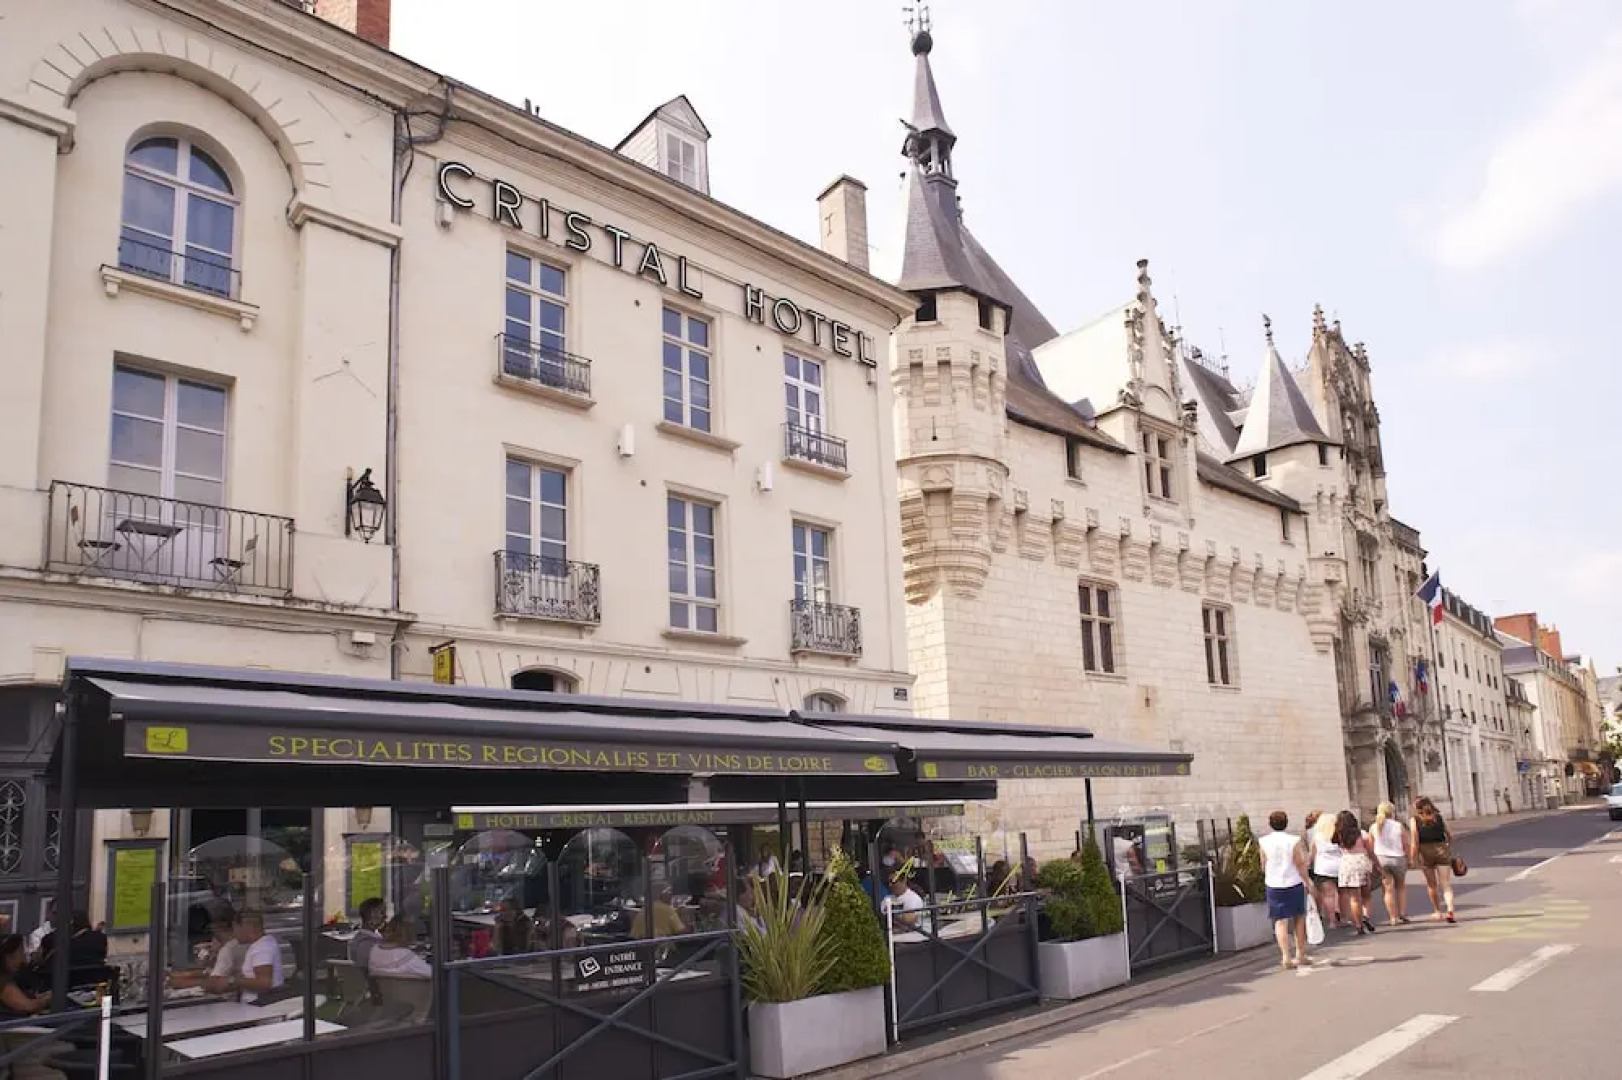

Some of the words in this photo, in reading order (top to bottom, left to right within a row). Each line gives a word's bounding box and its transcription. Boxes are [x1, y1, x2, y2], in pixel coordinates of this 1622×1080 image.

[437, 161, 703, 299] CRISTAL
[744, 283, 877, 368] HOTEL
[268, 735, 473, 762] SPECIALITES
[482, 745, 650, 768] REGIONALES
[656, 752, 680, 767] ET
[688, 753, 741, 769] VINS
[747, 755, 774, 770] DE
[778, 757, 833, 771] LOIRE
[967, 765, 998, 777] BAR
[486, 814, 538, 827] HOTEL
[549, 813, 613, 826] CRISTAL
[623, 811, 714, 824] RESTAURANT
